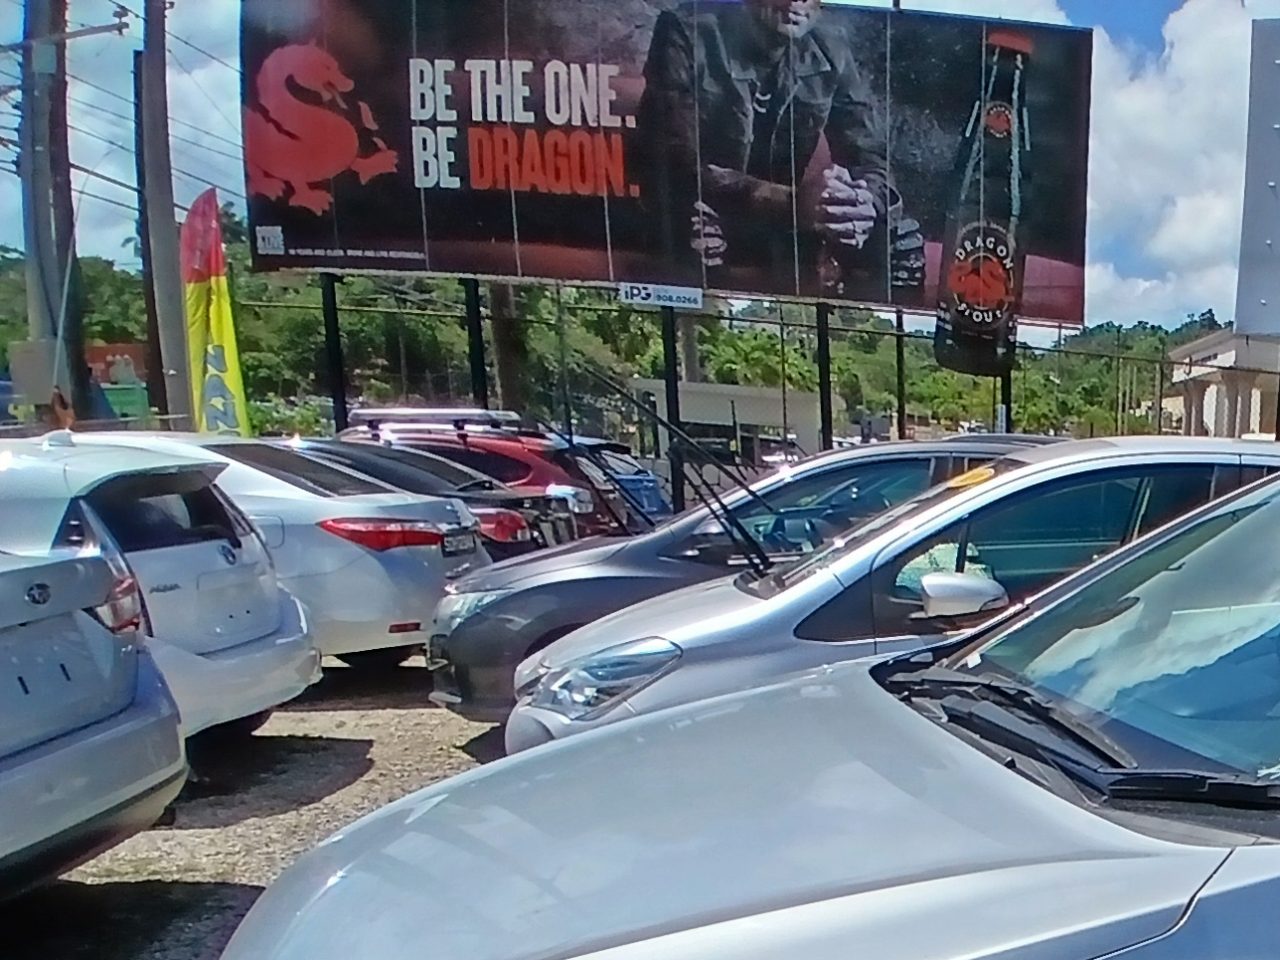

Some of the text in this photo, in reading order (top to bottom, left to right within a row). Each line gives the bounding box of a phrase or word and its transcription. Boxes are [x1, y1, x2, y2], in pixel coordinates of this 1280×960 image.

[409, 58, 636, 128] BE THE ONE.
[412, 126, 640, 198] BE DRAGON.
[955, 236, 1014, 269] DRAGON
